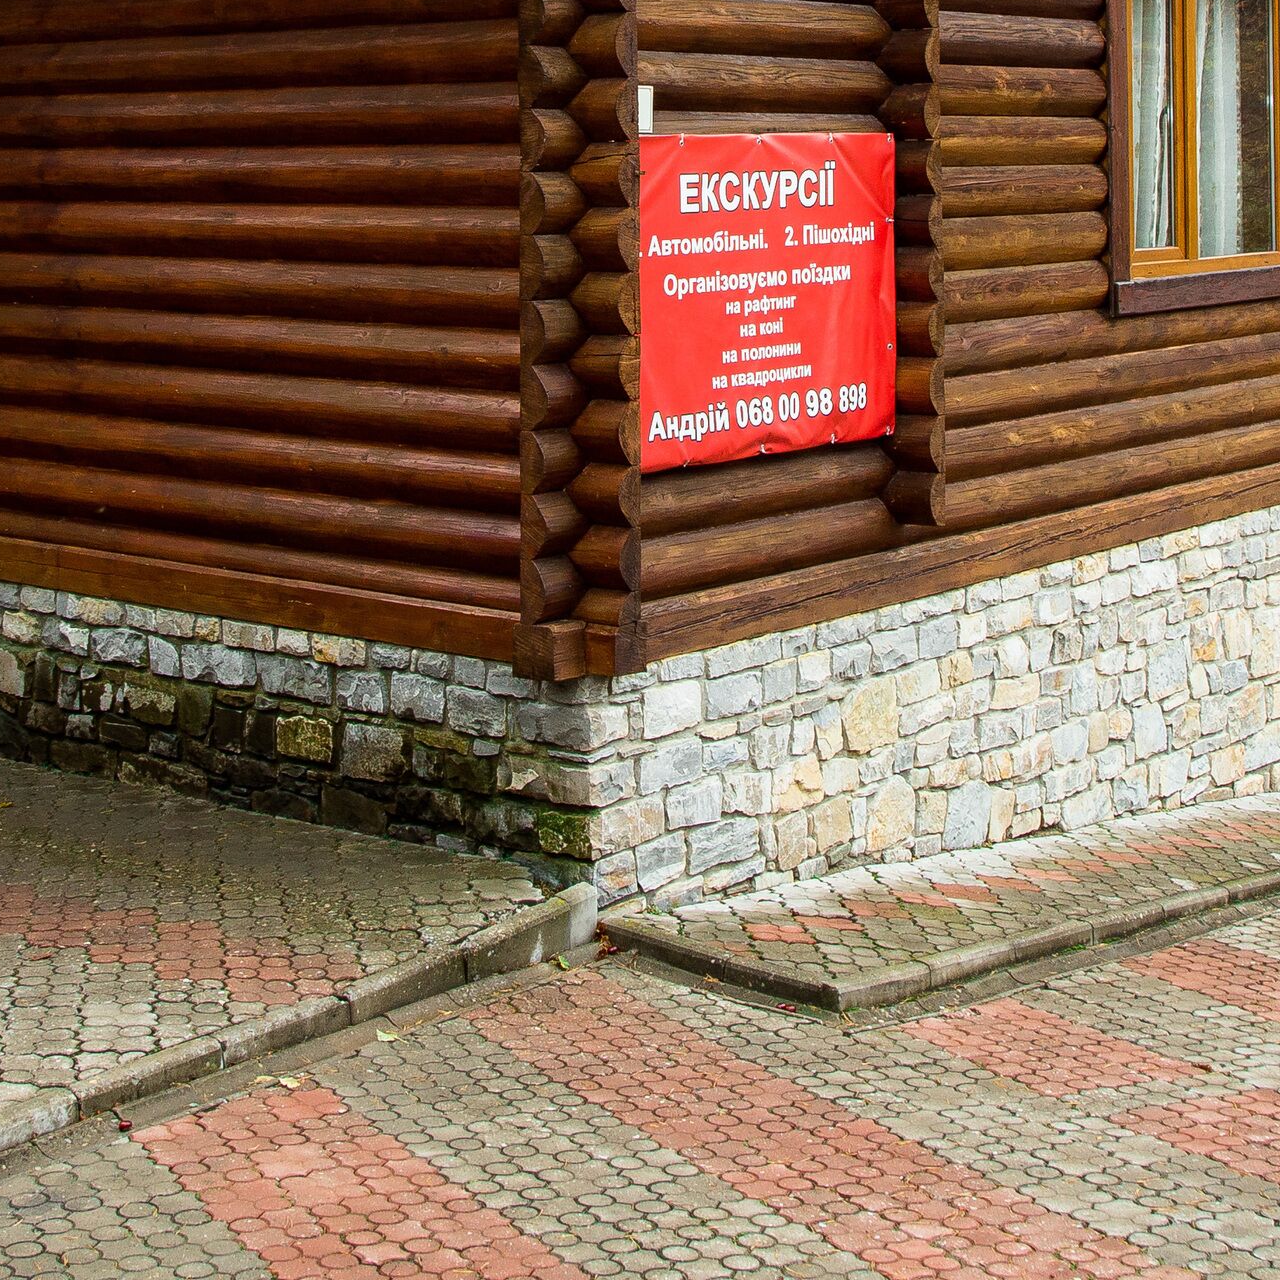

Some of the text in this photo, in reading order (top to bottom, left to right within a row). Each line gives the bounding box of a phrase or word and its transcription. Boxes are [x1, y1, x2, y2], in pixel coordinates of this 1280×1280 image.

[679, 160, 836, 214] ЕКСКУРСІЇ
[647, 221, 875, 257] Автомобільні. 2. Пішохідні
[663, 262, 851, 301] Організовуємо поїздки
[725, 294, 797, 317] на рафтинг
[739, 316, 784, 338] на коні
[722, 342, 802, 364] на полонини
[711, 364, 812, 390] на квадроцикли
[648, 382, 867, 442] Андрій 068 00 98 898
